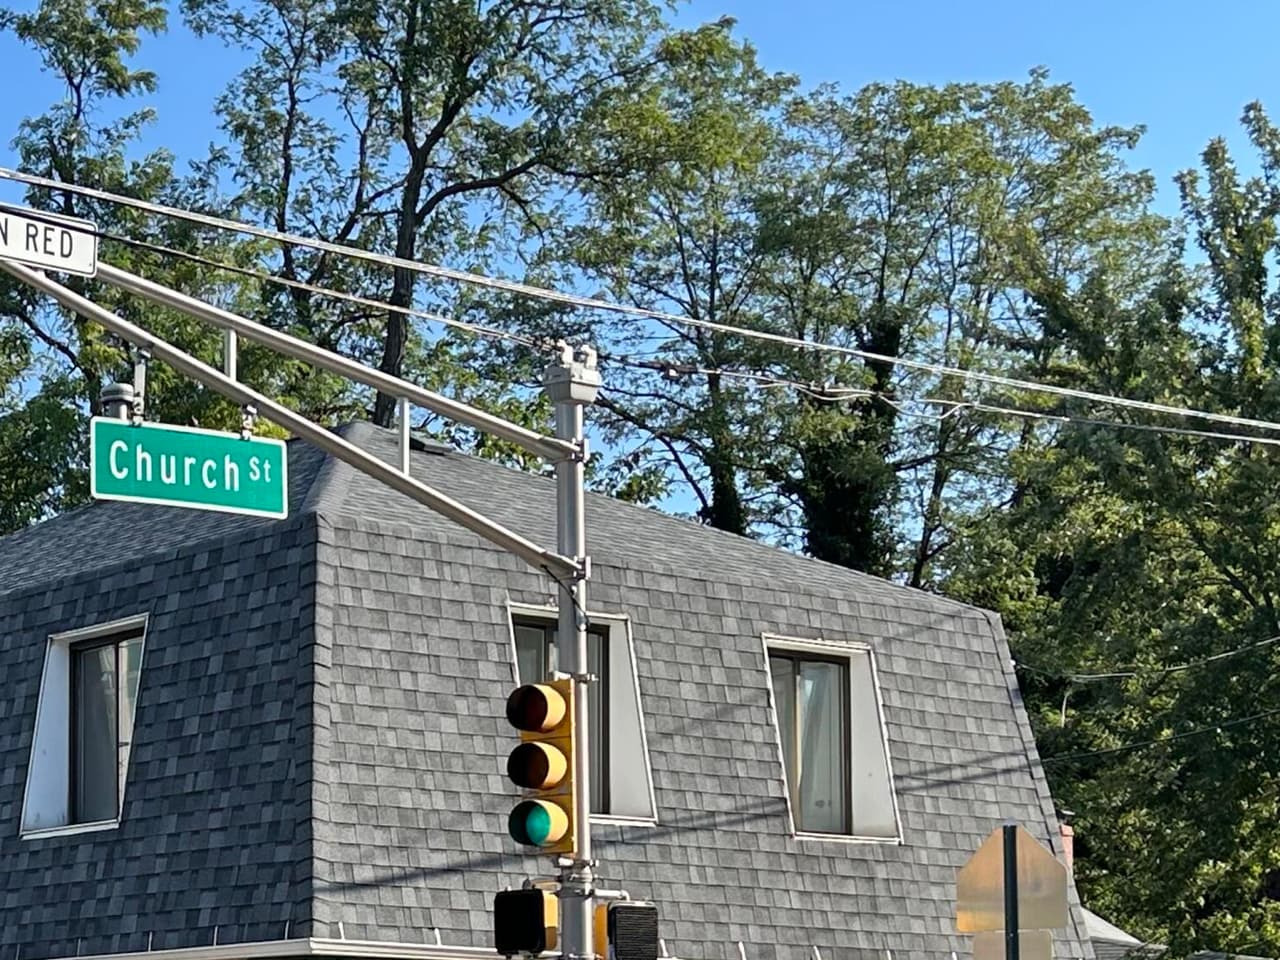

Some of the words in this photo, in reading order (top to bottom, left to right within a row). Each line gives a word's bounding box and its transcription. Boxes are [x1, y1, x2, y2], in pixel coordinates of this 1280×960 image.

[25, 223, 73, 258] RED
[109, 440, 240, 492] Church
[249, 456, 271, 483] St
